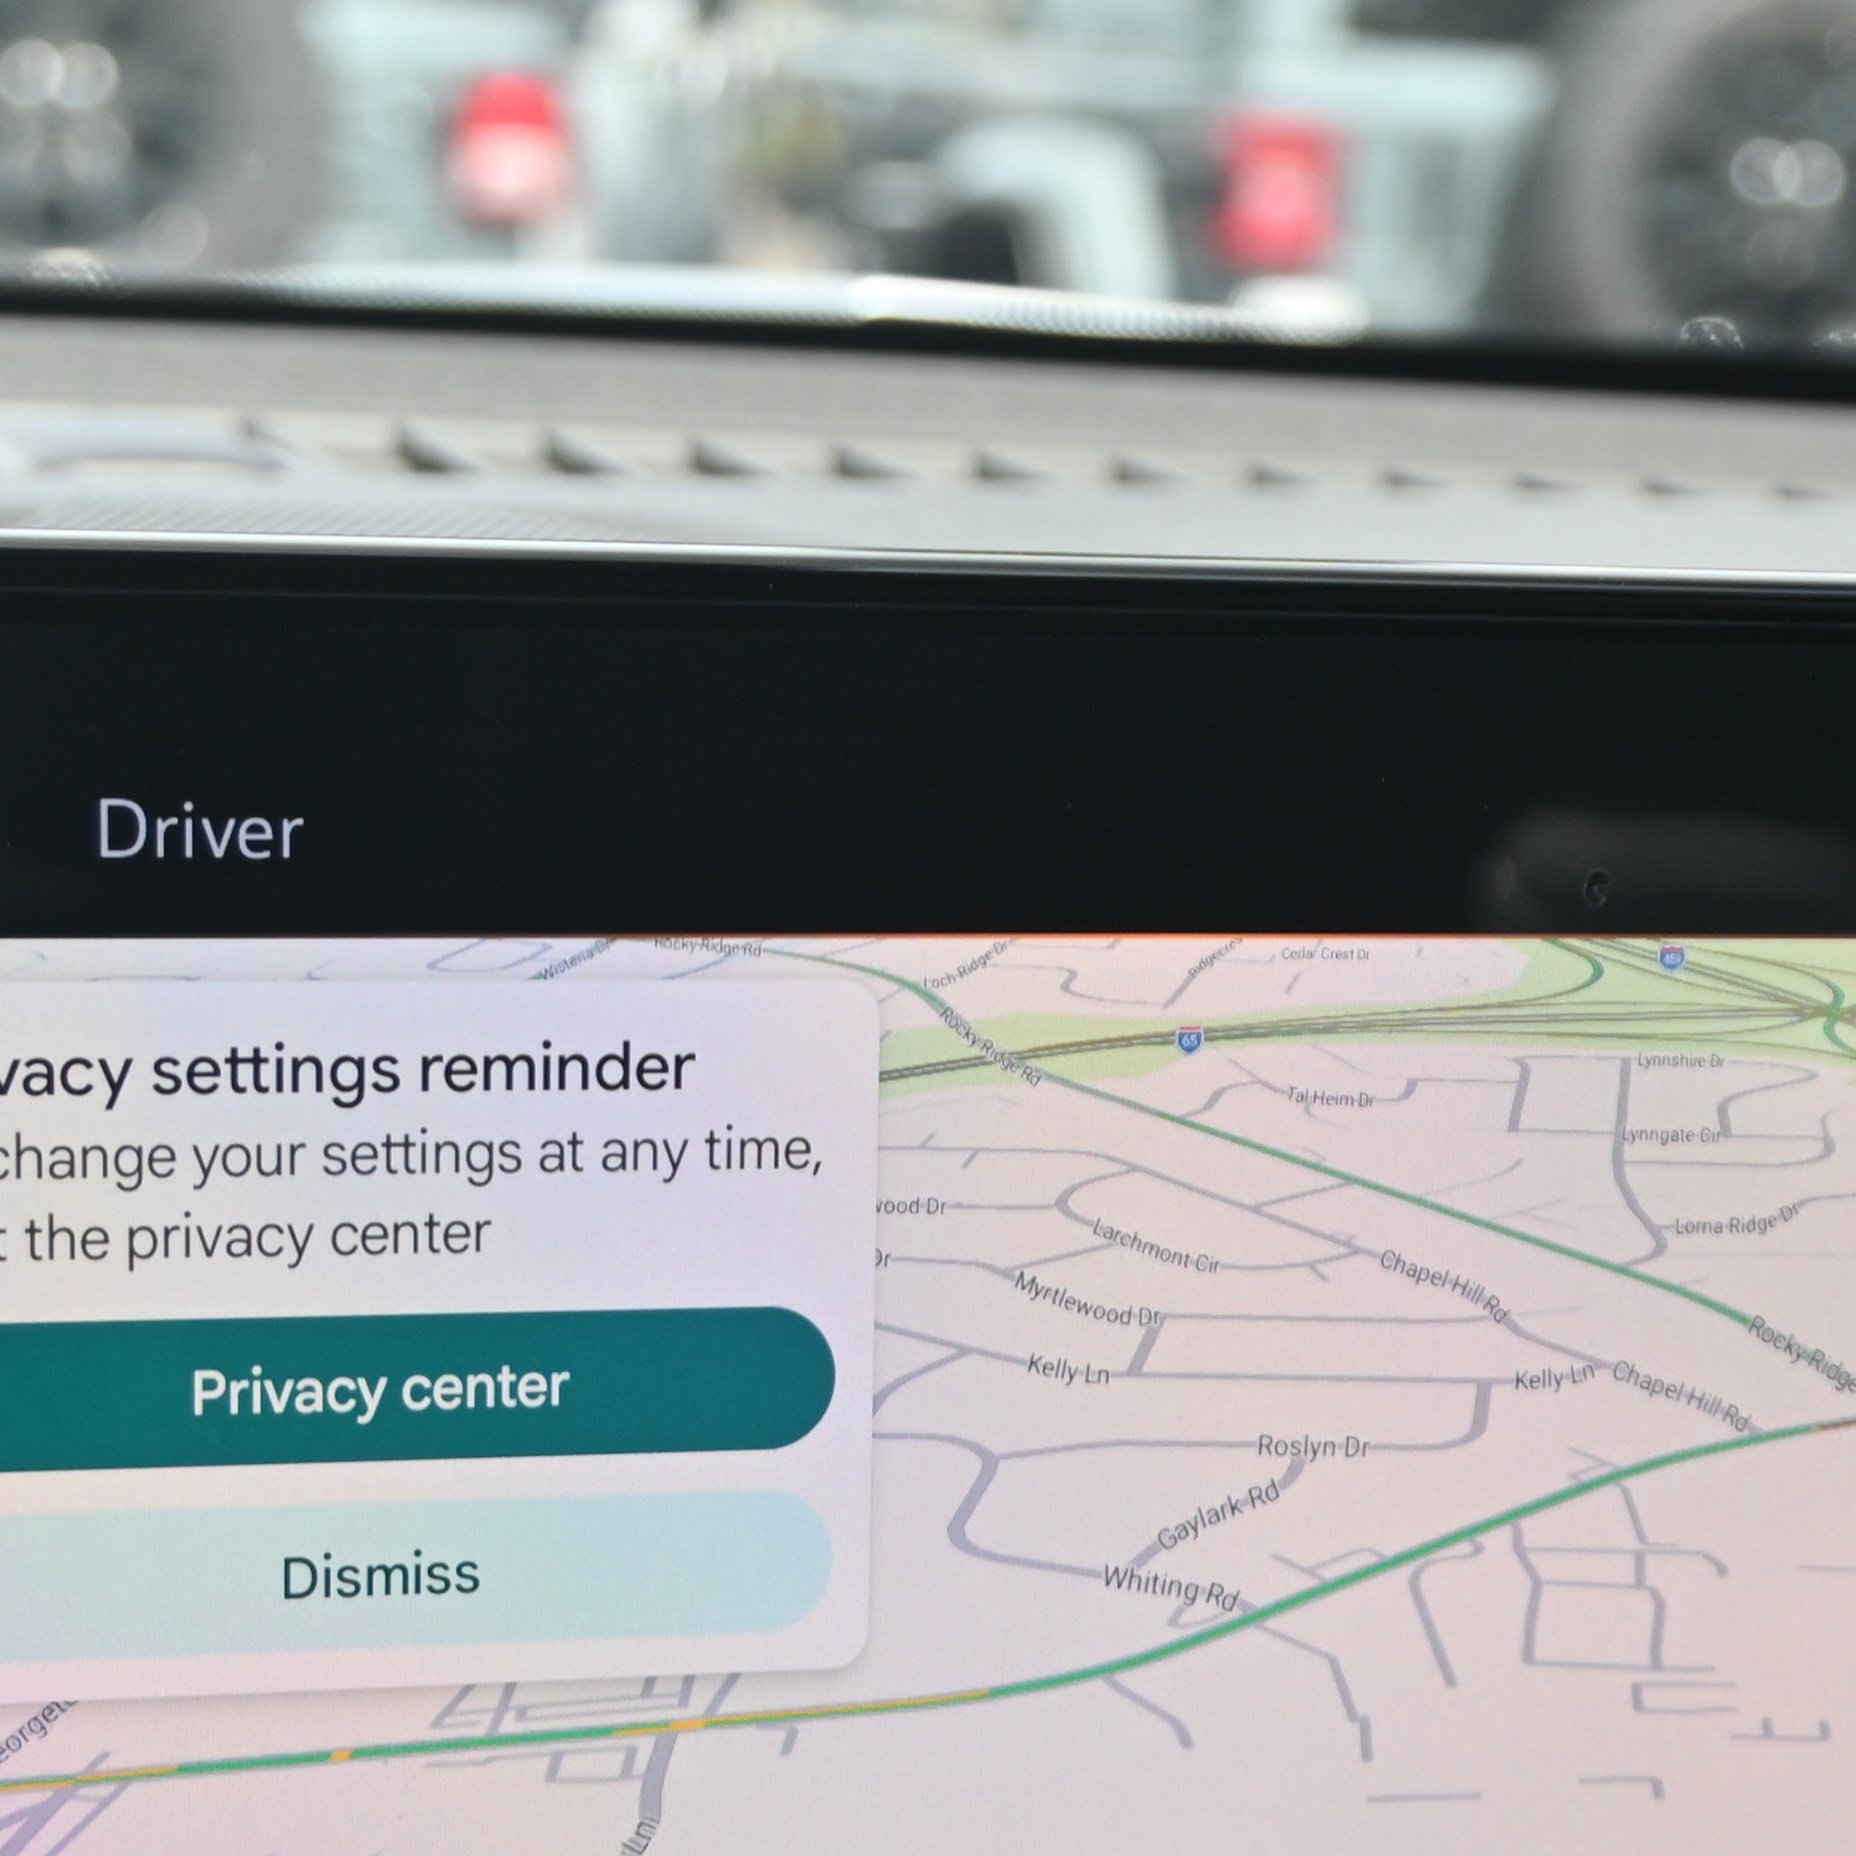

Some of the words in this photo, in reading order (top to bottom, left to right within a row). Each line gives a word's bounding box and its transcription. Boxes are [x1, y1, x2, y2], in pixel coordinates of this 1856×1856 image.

[98, 797, 305, 860] Driver
[957, 949, 994, 979] Ridge
[939, 1006, 979, 1047] Rocky
[981, 1039, 1021, 1073] Ridge
[1021, 1064, 1043, 1088] Rd
[1181, 1033, 1198, 1047] 65
[1638, 1052, 1707, 1069] Lynnshire
[1710, 1053, 1726, 1068] Dr
[152, 1041, 402, 1109] settings
[419, 1039, 696, 1093] reminder
[1286, 1085, 1309, 1103] Tal
[1313, 1089, 1355, 1107] Heim
[1359, 1091, 1375, 1108] Dr
[191, 1139, 307, 1190] your
[321, 1126, 523, 1188] settings
[538, 1131, 584, 1174] at
[600, 1137, 690, 1184] any
[704, 1123, 824, 1177] time,
[1621, 1125, 1696, 1146] Lynngate
[926, 1196, 947, 1215] Dr
[1728, 1213, 1778, 1235] Ridge
[1779, 1202, 1801, 1223] Dr
[24, 1211, 111, 1261] the
[127, 1210, 315, 1272] privacy
[330, 1213, 493, 1257] center
[1093, 1217, 1191, 1269] Larchmont
[1194, 1253, 1221, 1274] Cir
[1014, 1270, 1134, 1327] Myrtlewood
[1138, 1306, 1162, 1327] Dr
[1380, 1249, 1450, 1289] Chapel
[1451, 1274, 1486, 1306] Hill
[1483, 1294, 1512, 1324] Rd
[1747, 1314, 1805, 1364] Rocky
[192, 1365, 387, 1425] Privacy
[401, 1364, 572, 1413] center
[1026, 1352, 1079, 1387] Kelly
[1084, 1363, 1110, 1385] Ln
[1514, 1367, 1564, 1393] Kelly
[1570, 1363, 1596, 1384] Ln
[1612, 1359, 1685, 1402] Chapel
[1686, 1386, 1723, 1417] Hill
[1721, 1404, 1752, 1433] Rd
[1257, 1434, 1336, 1463] Roslyn
[1344, 1435, 1371, 1458] Dr
[1157, 1494, 1244, 1551] Gaylark
[1248, 1477, 1281, 1509] Rd
[282, 1549, 482, 1600] Dismiss
[1103, 1563, 1201, 1607] Whiting
[1206, 1581, 1241, 1612] Rd
[621, 1820, 658, 1856] Ln
